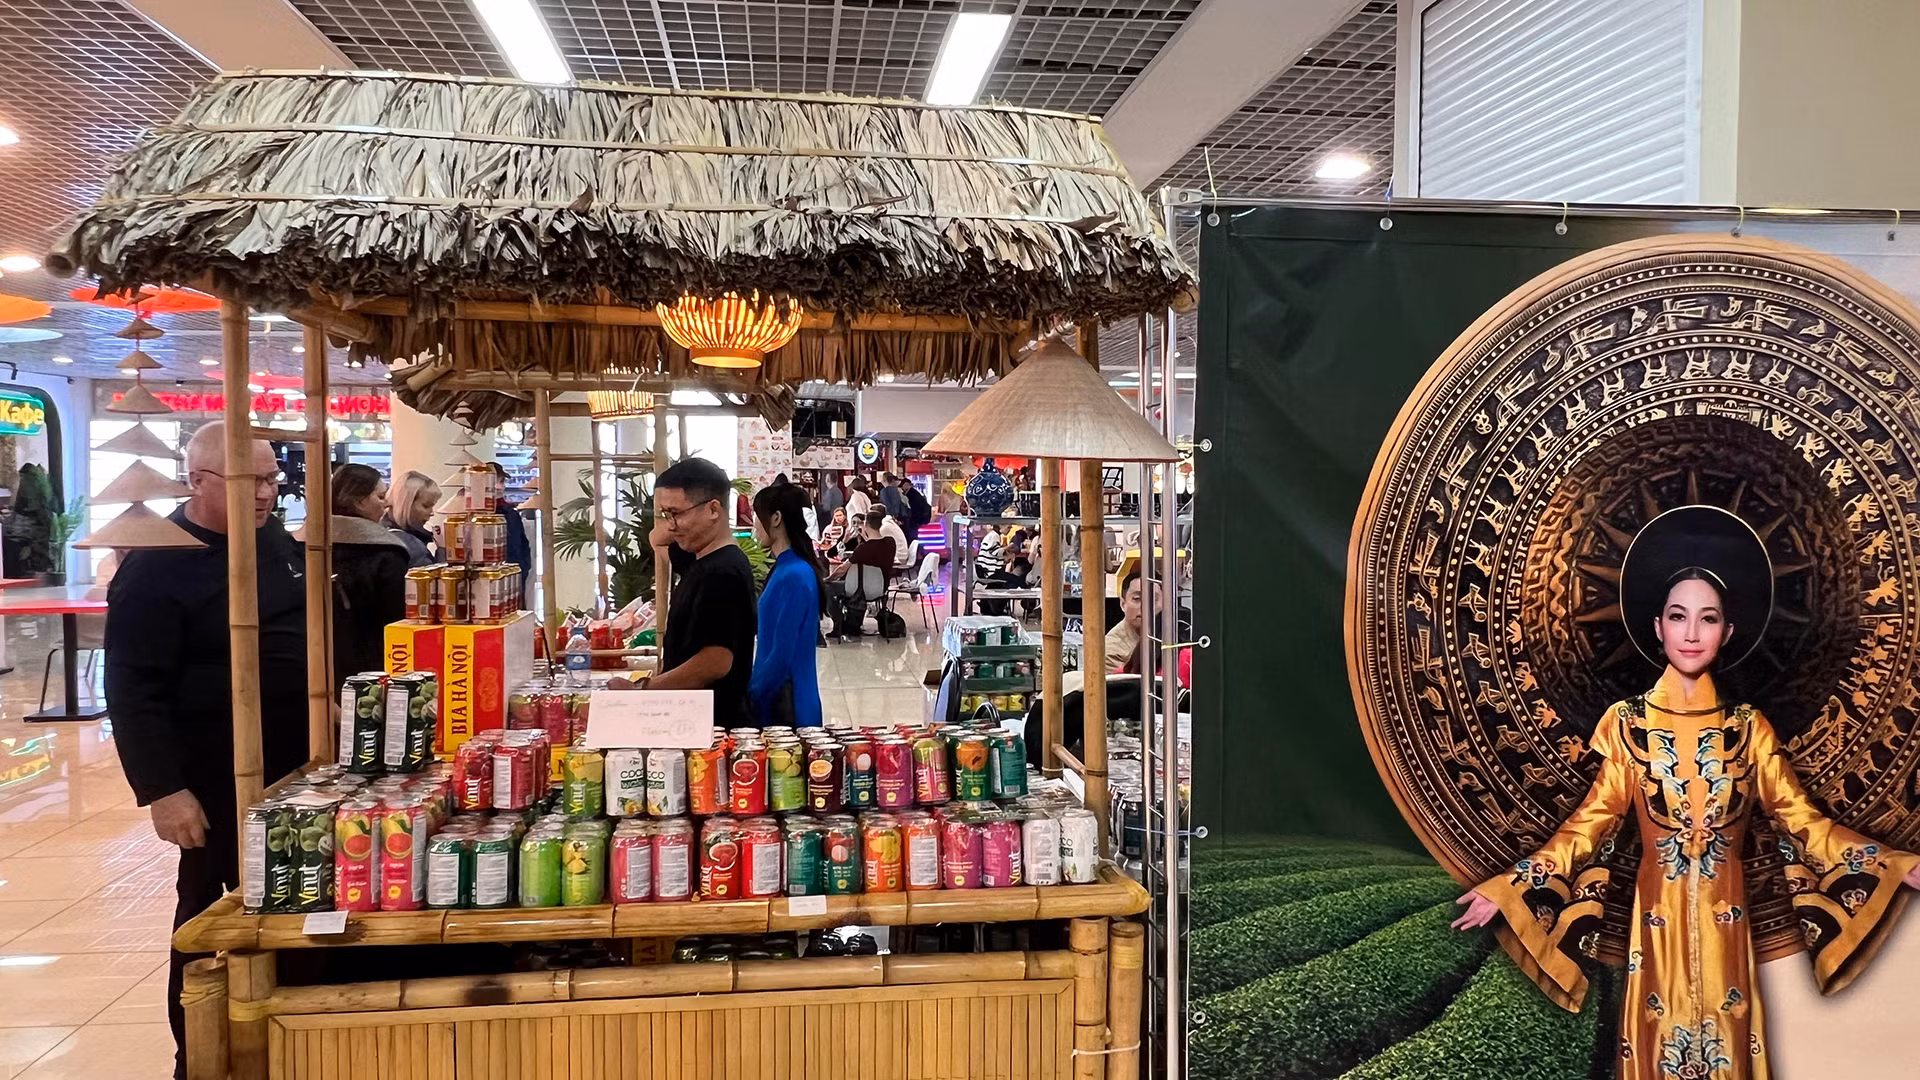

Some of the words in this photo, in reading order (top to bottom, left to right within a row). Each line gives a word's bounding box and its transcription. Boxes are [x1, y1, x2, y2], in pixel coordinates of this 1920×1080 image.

[388, 643, 411, 674] NỘI
[448, 644, 472, 674] NỘI
[447, 677, 468, 702] HÀ
[451, 706, 468, 735] BIA
[359, 728, 378, 766] Vinut
[409, 728, 424, 765] Vinut
[463, 777, 482, 810] Vinut
[271, 863, 290, 906] Vinut
[298, 862, 322, 906] Vinut
[865, 859, 879, 890] Vinut
[1008, 850, 1022, 886] Vinut
